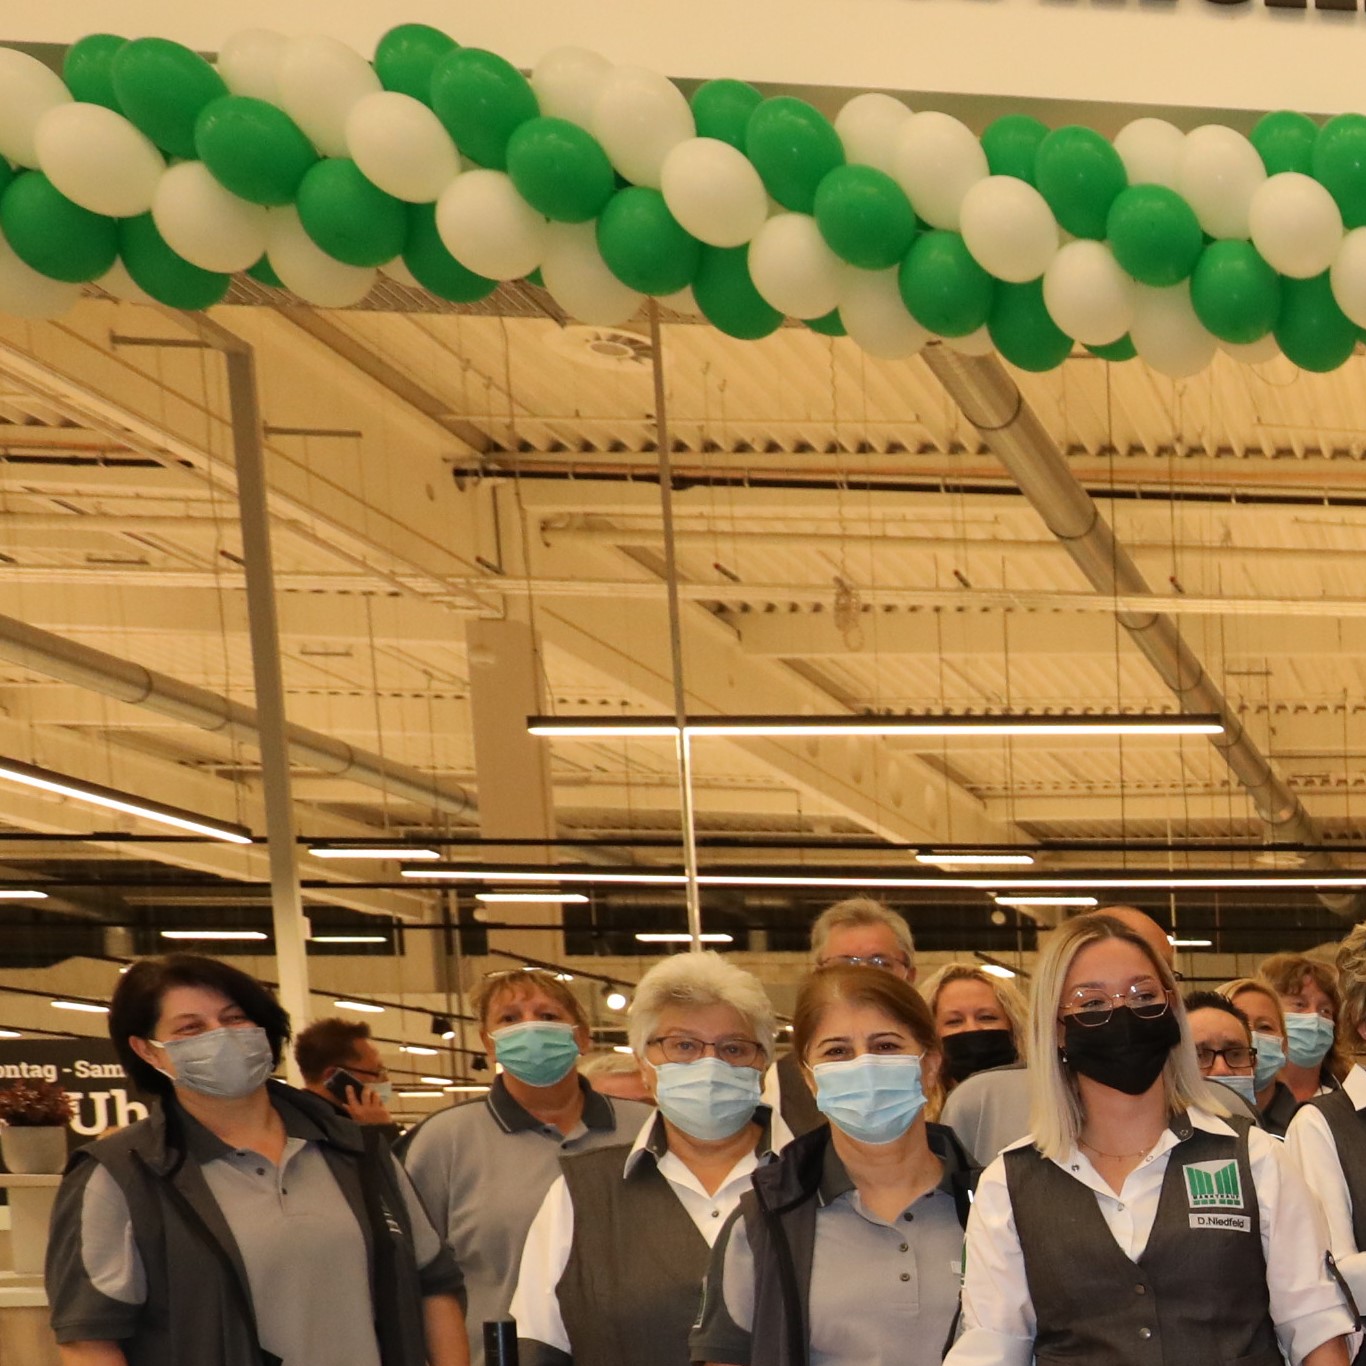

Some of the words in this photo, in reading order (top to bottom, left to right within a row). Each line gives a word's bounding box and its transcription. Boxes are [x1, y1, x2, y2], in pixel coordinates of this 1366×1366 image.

[0, 1061, 58, 1083] ontag
[74, 1060, 127, 1079] Sam
[63, 1089, 149, 1136] Uh
